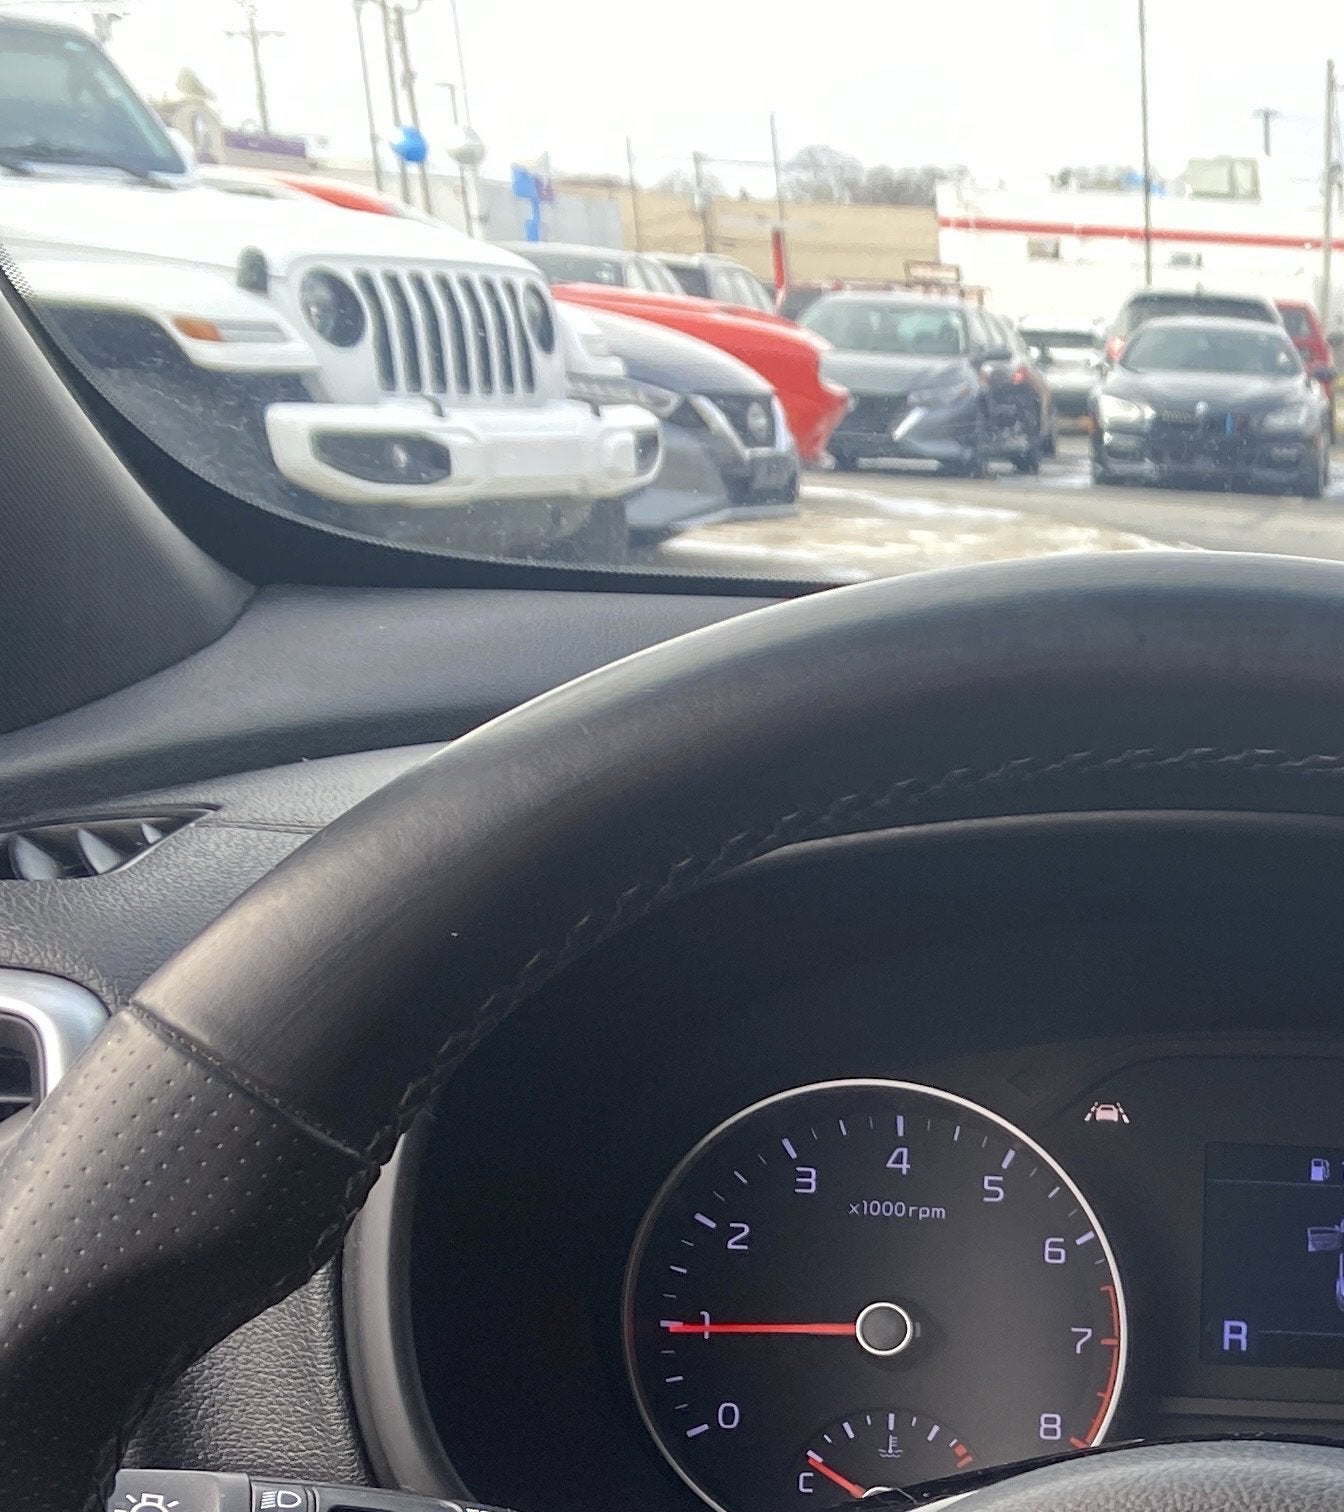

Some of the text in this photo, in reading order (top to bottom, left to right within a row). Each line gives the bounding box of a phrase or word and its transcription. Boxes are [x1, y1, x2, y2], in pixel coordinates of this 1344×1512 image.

[886, 1147, 911, 1175] 4
[794, 1167, 817, 1194] 3
[983, 1175, 1005, 1203] 5
[727, 1222, 750, 1250] 2
[1044, 1237, 1066, 1264] 6
[1070, 1327, 1092, 1354] 7
[1223, 1320, 1248, 1351] R
[718, 1403, 740, 1430] 0
[1039, 1413, 1062, 1440] 8
[800, 1472, 814, 1494] C
